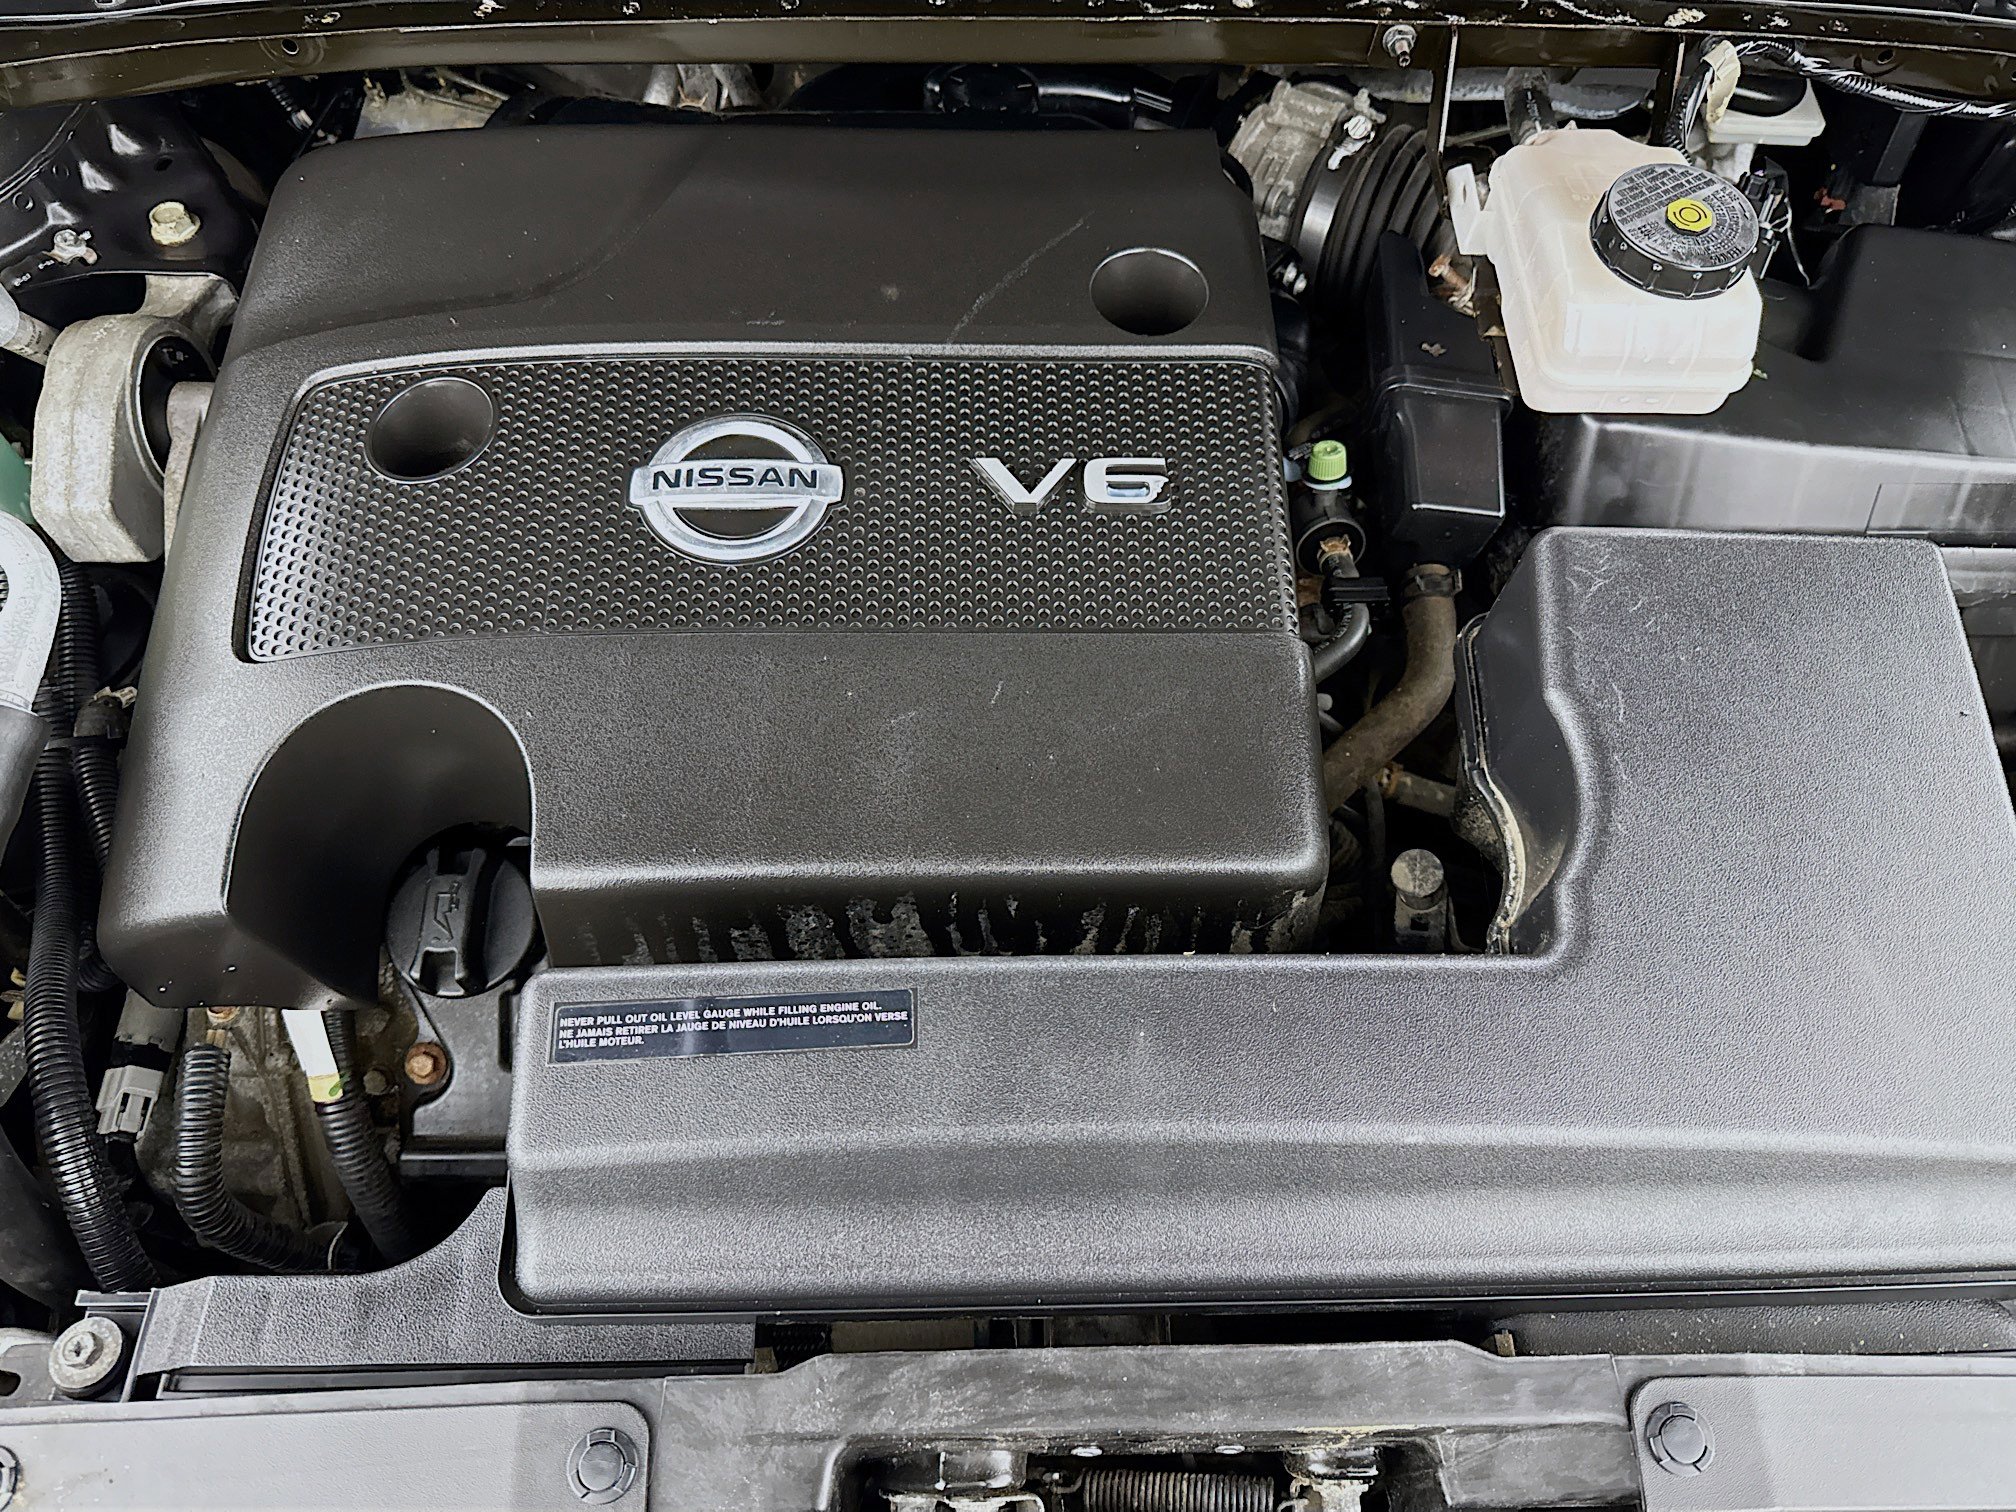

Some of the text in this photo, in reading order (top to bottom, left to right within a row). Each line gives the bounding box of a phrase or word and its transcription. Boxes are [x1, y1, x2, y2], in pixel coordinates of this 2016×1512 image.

[651, 466, 820, 490] NISSAN
[970, 456, 1172, 514] V6
[559, 1011, 908, 1039] NE JAMAIS RETIRER LA JAUGE DE NIVEAU D'HUILE LORSQU'ON VERSE
[560, 1000, 882, 1027] NEVER PULL OUT OIL LEVEL GAUGE WHILE FILLING ENGINE OIL.
[559, 1036, 645, 1049] L'HUILE MOTEUR.
